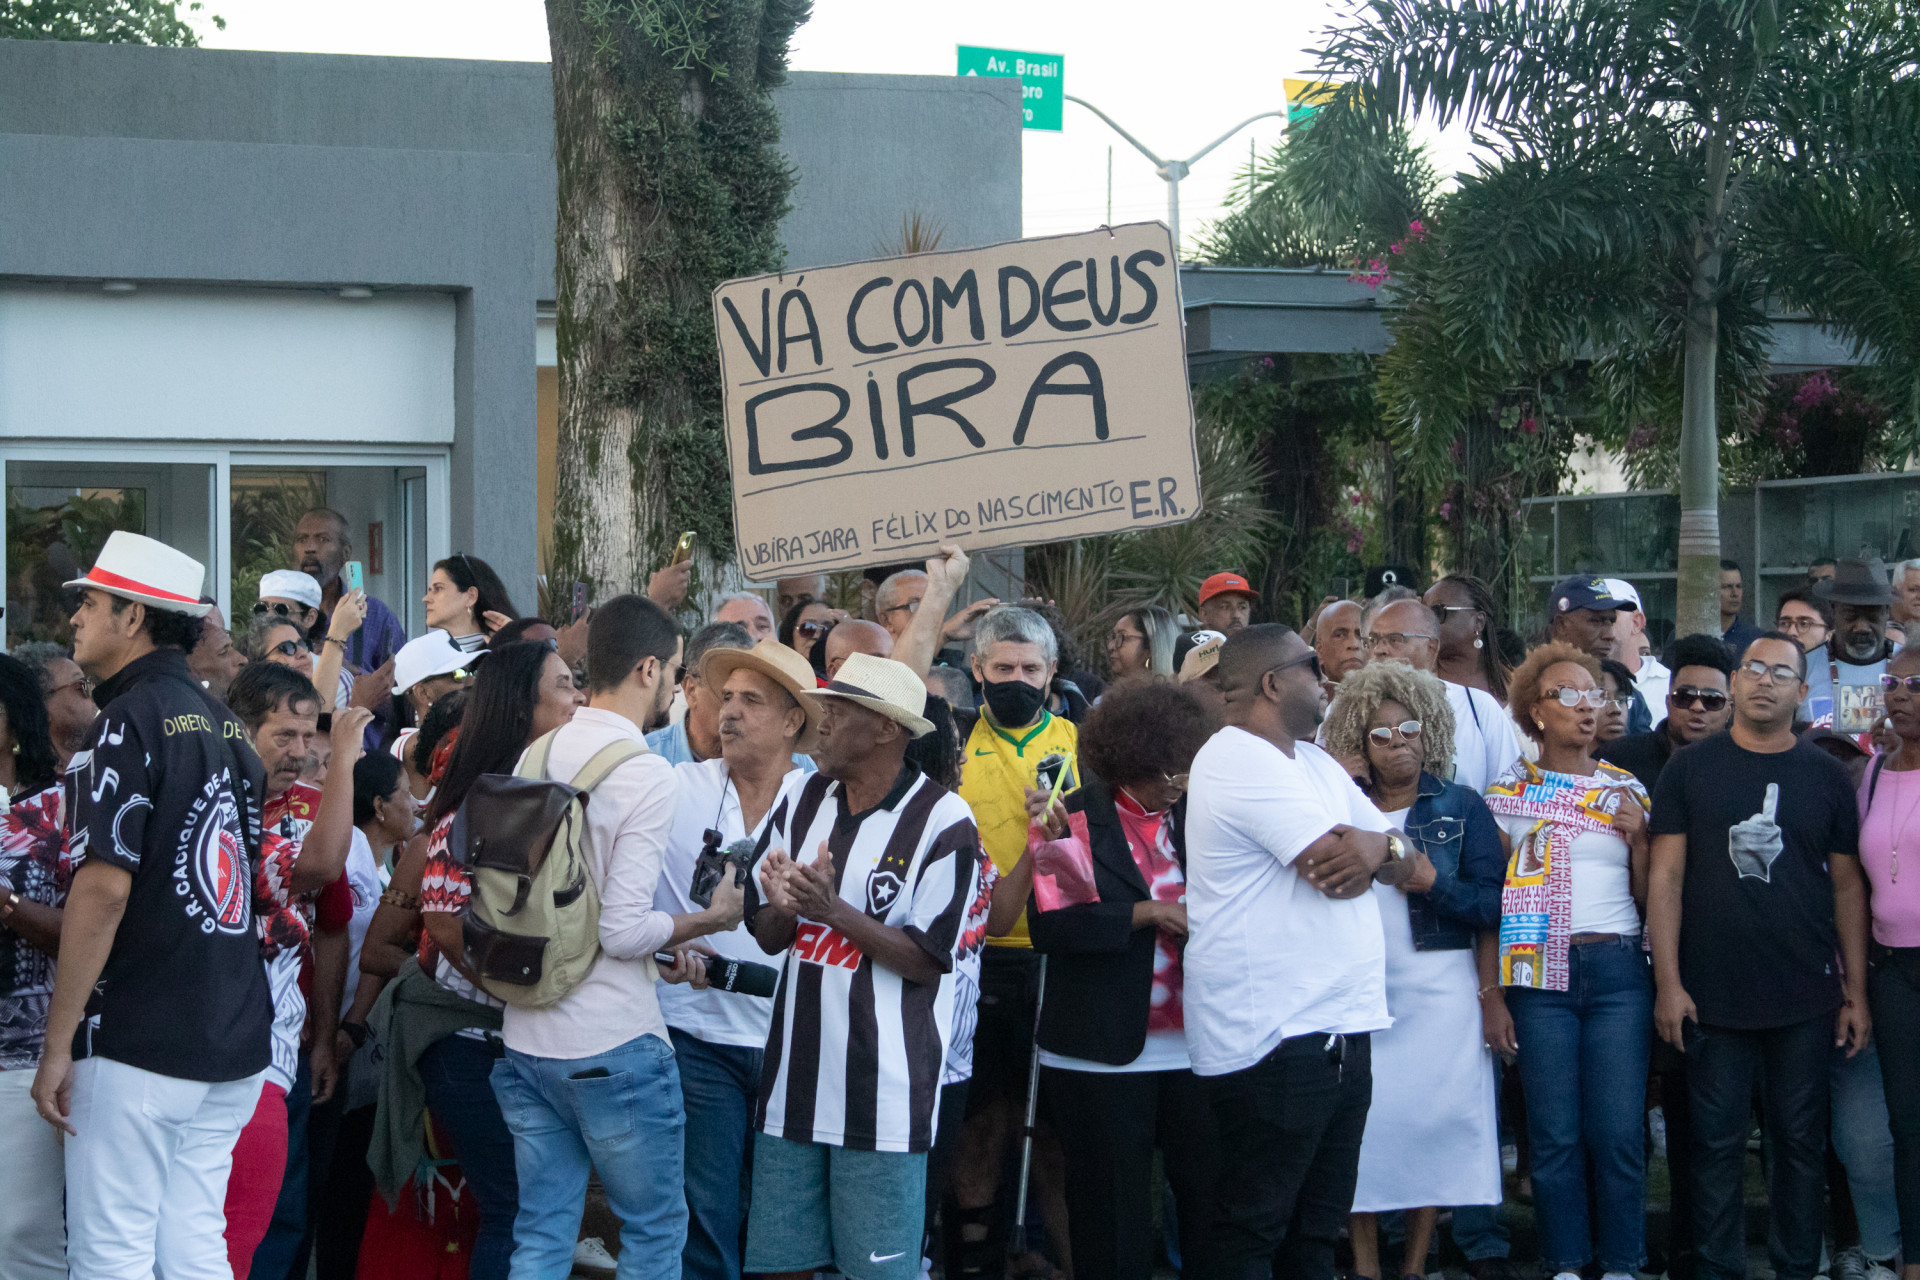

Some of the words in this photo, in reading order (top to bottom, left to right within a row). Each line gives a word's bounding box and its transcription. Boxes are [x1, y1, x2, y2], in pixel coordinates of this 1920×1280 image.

[986, 56, 1010, 74] Av.
[1015, 58, 1058, 77] Brasil
[722, 275, 823, 377] VÁ
[847, 268, 985, 354] COM
[998, 249, 1166, 338] DEUS
[744, 351, 1110, 476] BIRA
[872, 510, 938, 544] FÉLIX
[945, 508, 970, 529] DO
[977, 479, 1124, 526] NASCIMENTO
[1129, 476, 1187, 520] E.R.
[163, 713, 212, 736] DIRETO
[223, 720, 243, 739] DE
